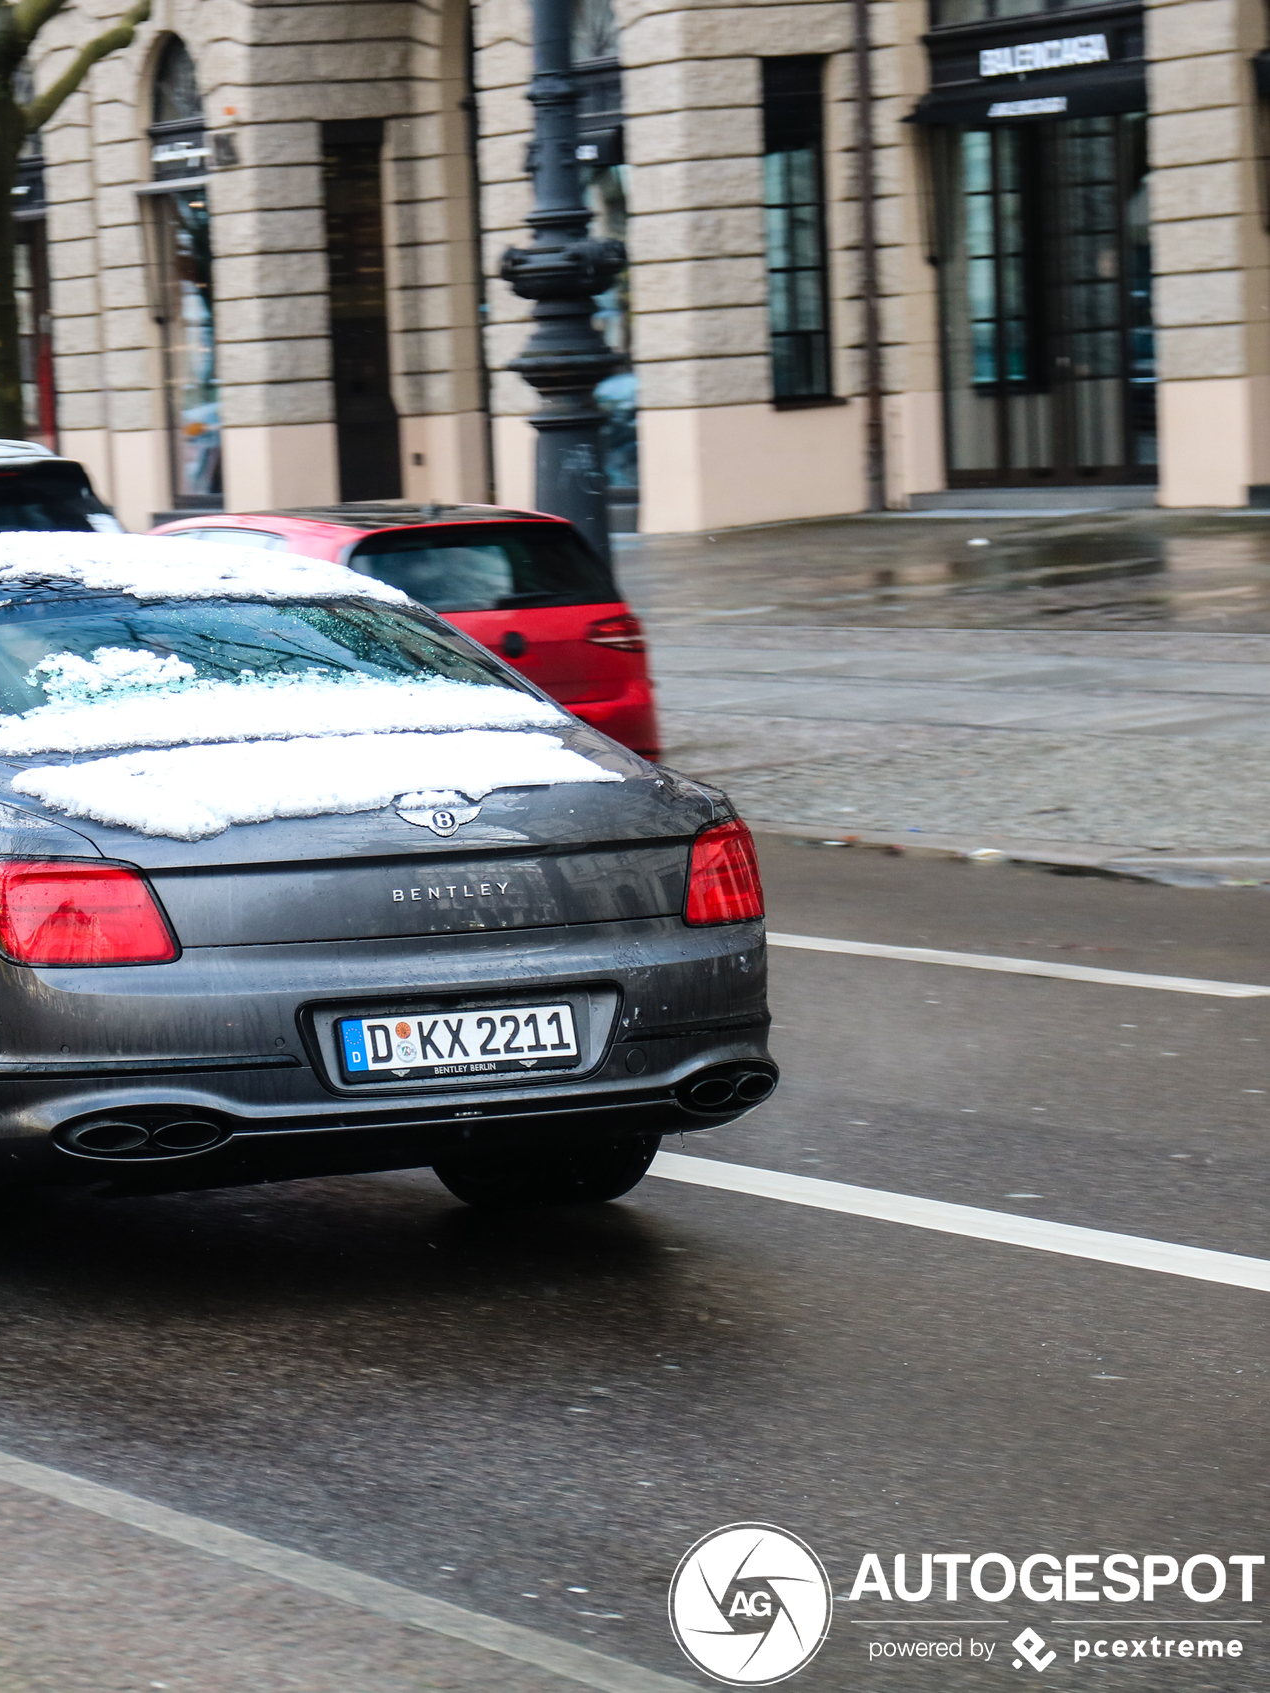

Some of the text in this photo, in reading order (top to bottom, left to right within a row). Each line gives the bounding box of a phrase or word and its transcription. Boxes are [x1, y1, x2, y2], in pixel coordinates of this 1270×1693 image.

[393, 882, 508, 902] BENTLEY
[367, 1012, 571, 1064] D KX 2211
[352, 1051, 361, 1063] D
[434, 1062, 497, 1075] BENTLEY BERLIN
